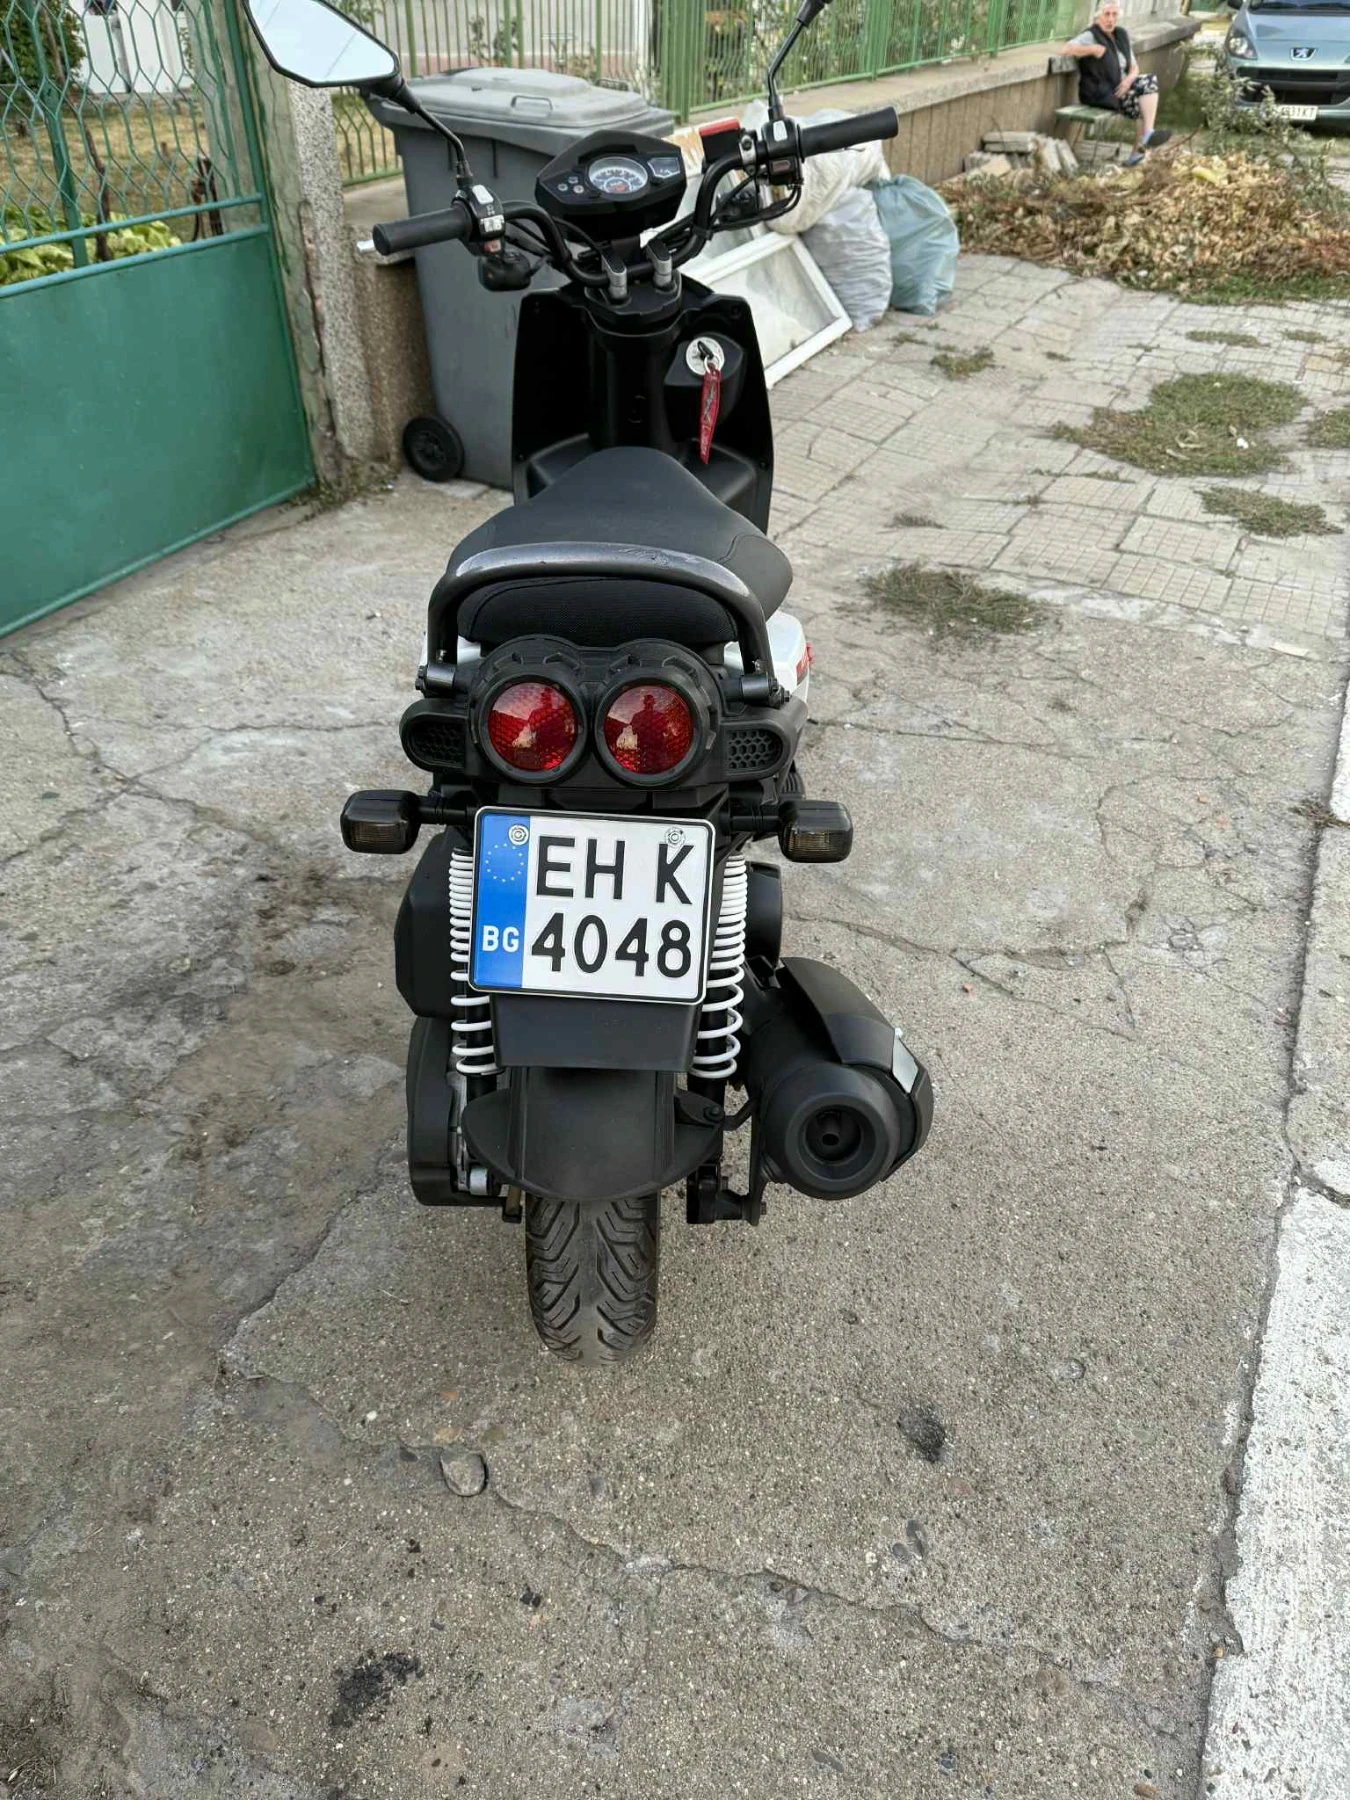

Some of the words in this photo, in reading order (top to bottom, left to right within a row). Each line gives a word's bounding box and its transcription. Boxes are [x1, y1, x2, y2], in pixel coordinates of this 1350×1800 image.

[536, 835, 626, 900] EH
[655, 843, 695, 905] K
[481, 925, 520, 953] BG
[531, 912, 692, 979] 4048
